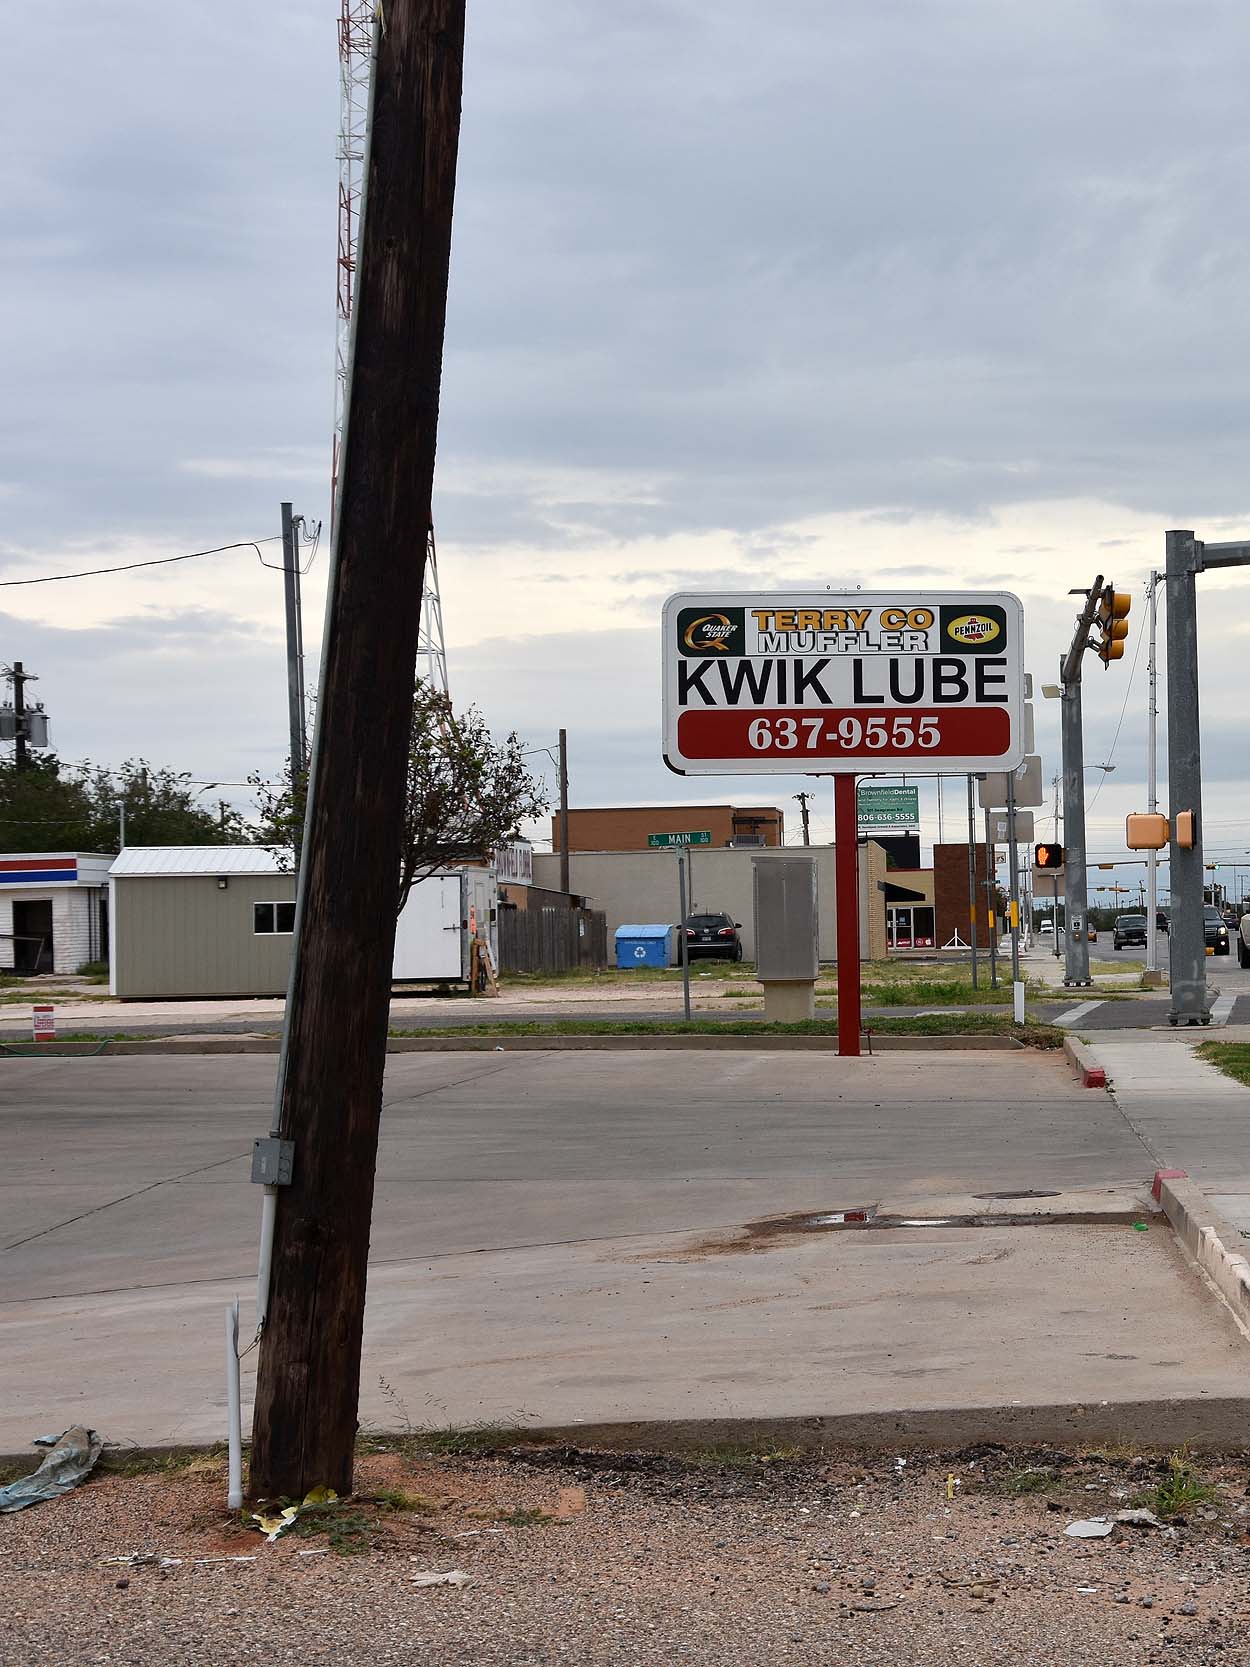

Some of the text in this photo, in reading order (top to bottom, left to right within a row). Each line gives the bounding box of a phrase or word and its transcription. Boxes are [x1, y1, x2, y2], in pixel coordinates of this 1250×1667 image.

[702, 623, 739, 634] QUAKER
[751, 607, 935, 631] TERRY CO
[705, 631, 731, 639] STATE
[954, 622, 993, 637] PENNZOIL
[757, 630, 929, 654] MUFFLER
[677, 656, 1009, 706] KWIK LUBE
[747, 716, 941, 750] 637-9555
[668, 833, 691, 845] MAIN
